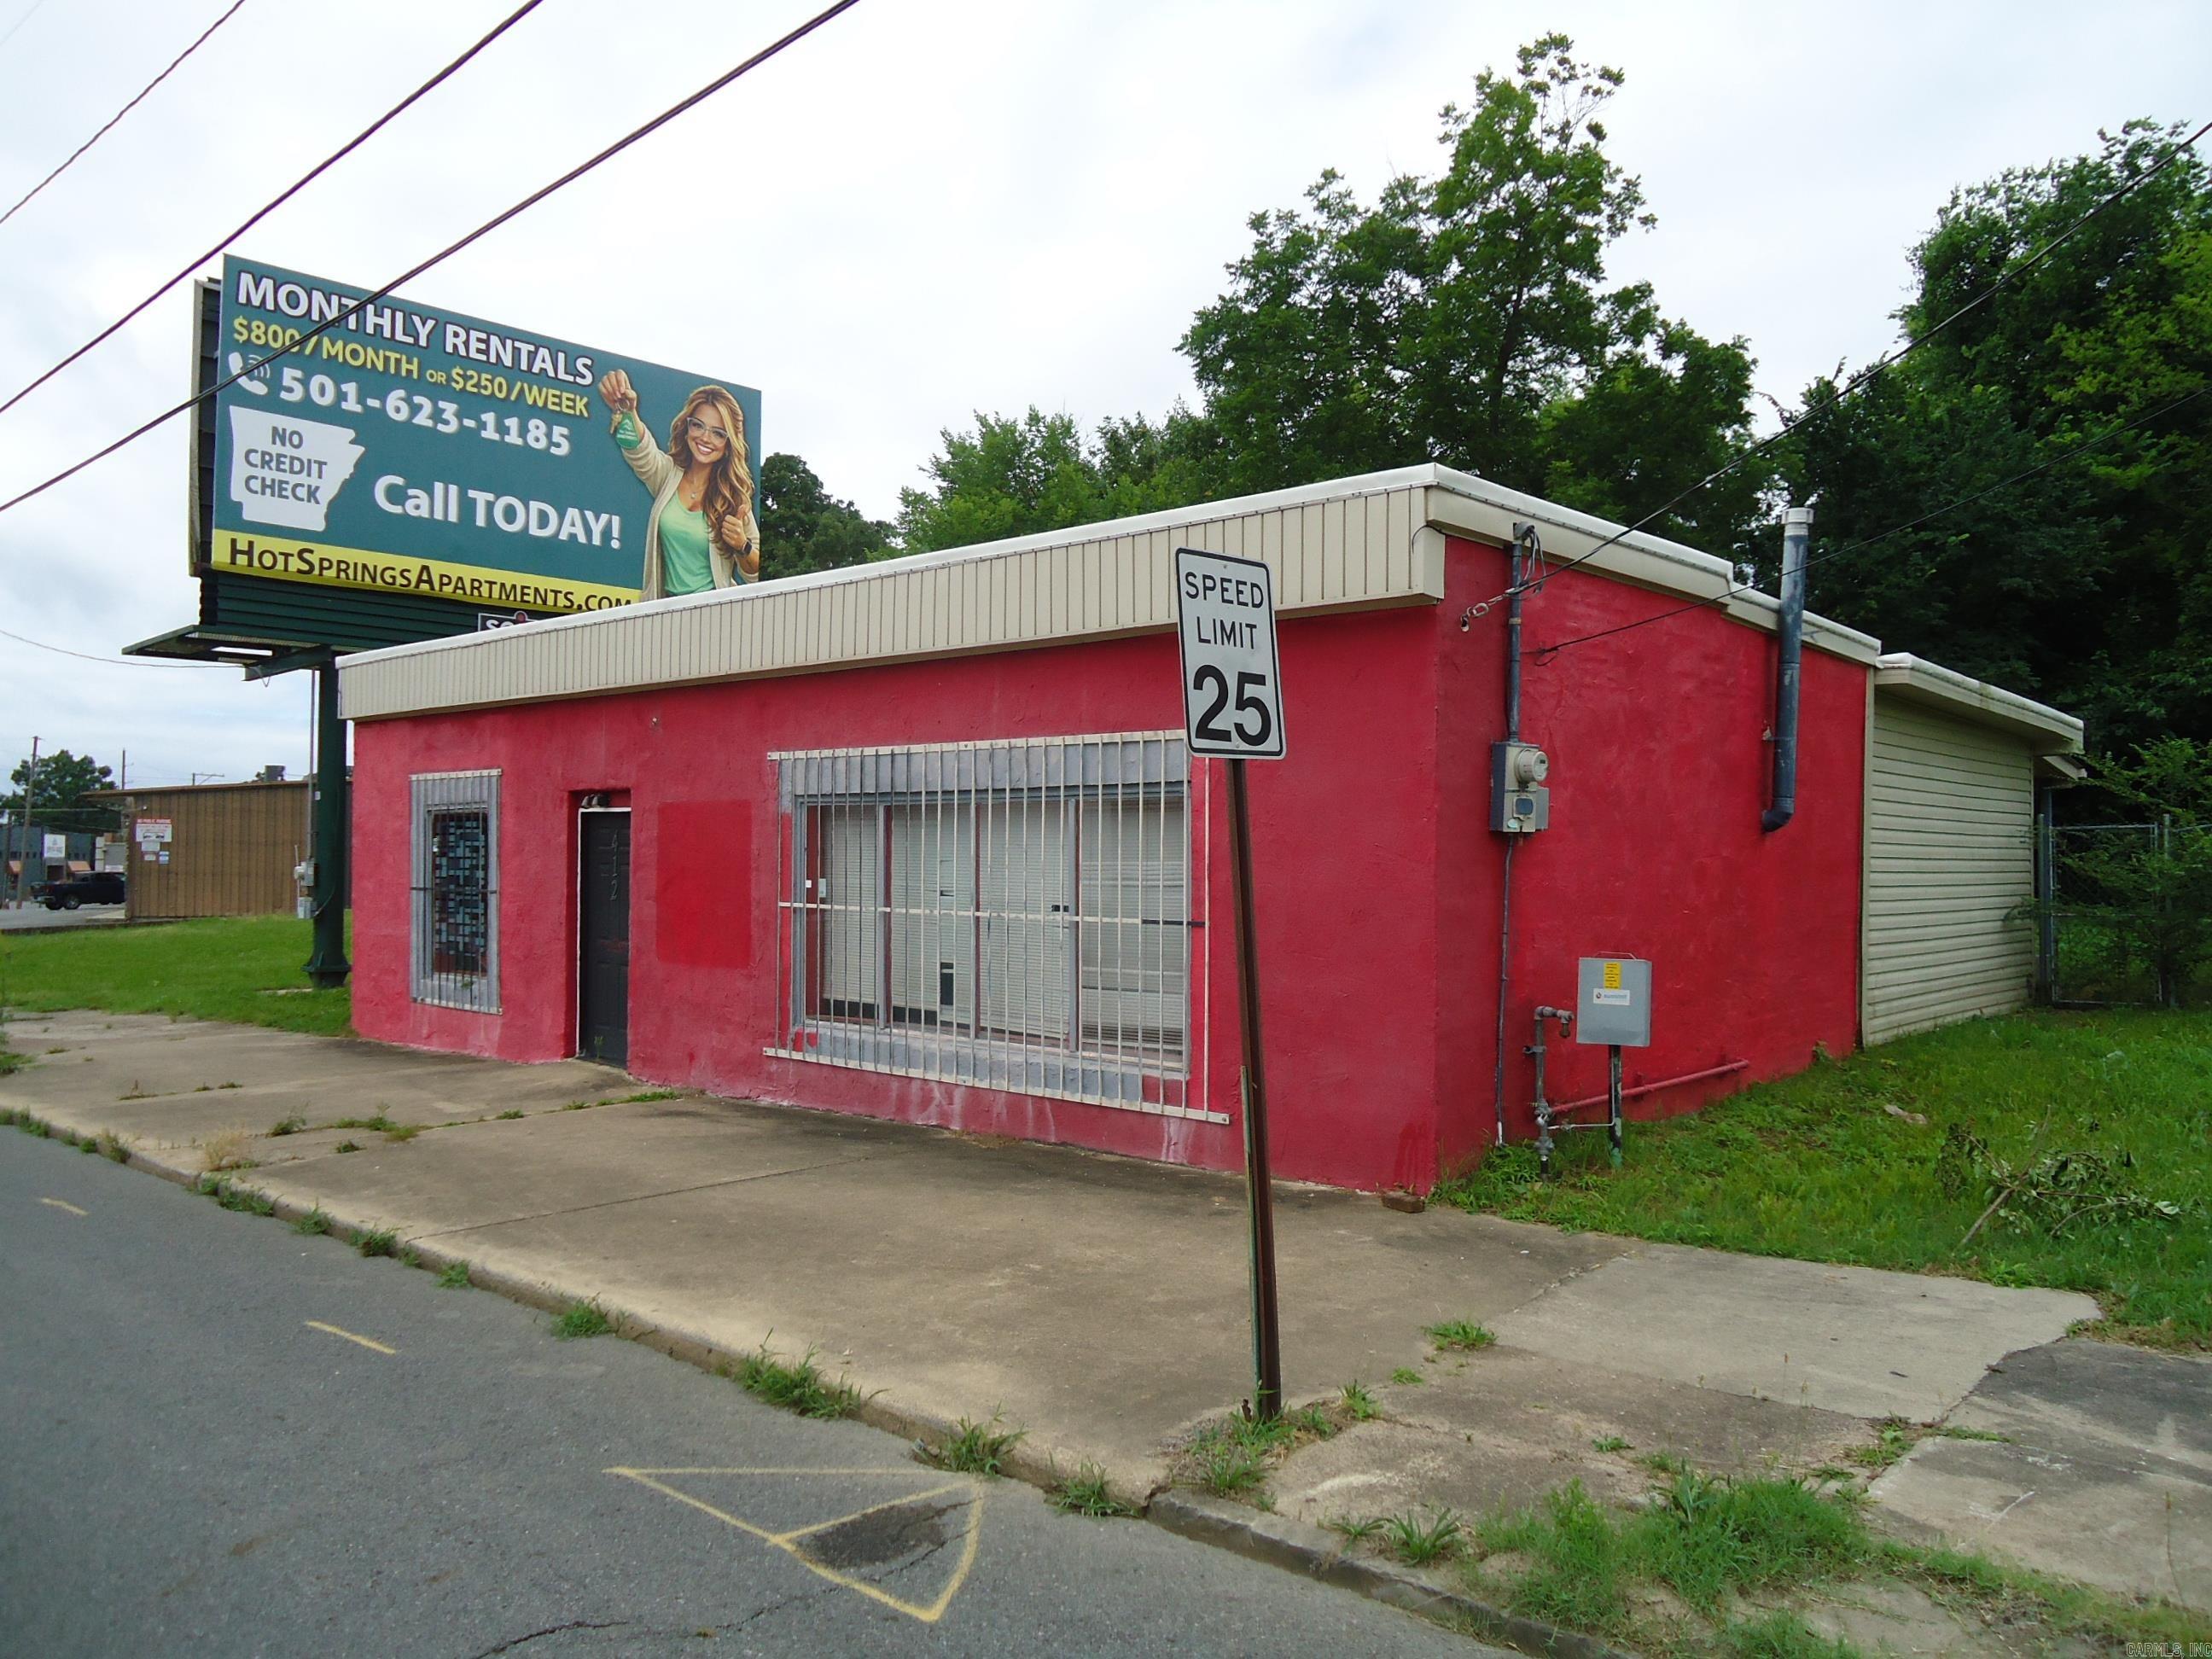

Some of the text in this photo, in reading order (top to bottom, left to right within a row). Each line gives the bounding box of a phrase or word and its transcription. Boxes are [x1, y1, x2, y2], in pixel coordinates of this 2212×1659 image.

[237, 271, 594, 386] MONTHLY RENTALS
[426, 370, 446, 385] OR
[279, 367, 570, 456] 501-623-1185
[271, 426, 304, 449] NO
[244, 449, 327, 479] CREDIT
[244, 475, 321, 504] CHECK
[374, 474, 622, 550] Call TODAY!
[1185, 571, 1264, 608] SPEED
[1196, 616, 1257, 649] LIMIT
[1193, 664, 1272, 747] 25
